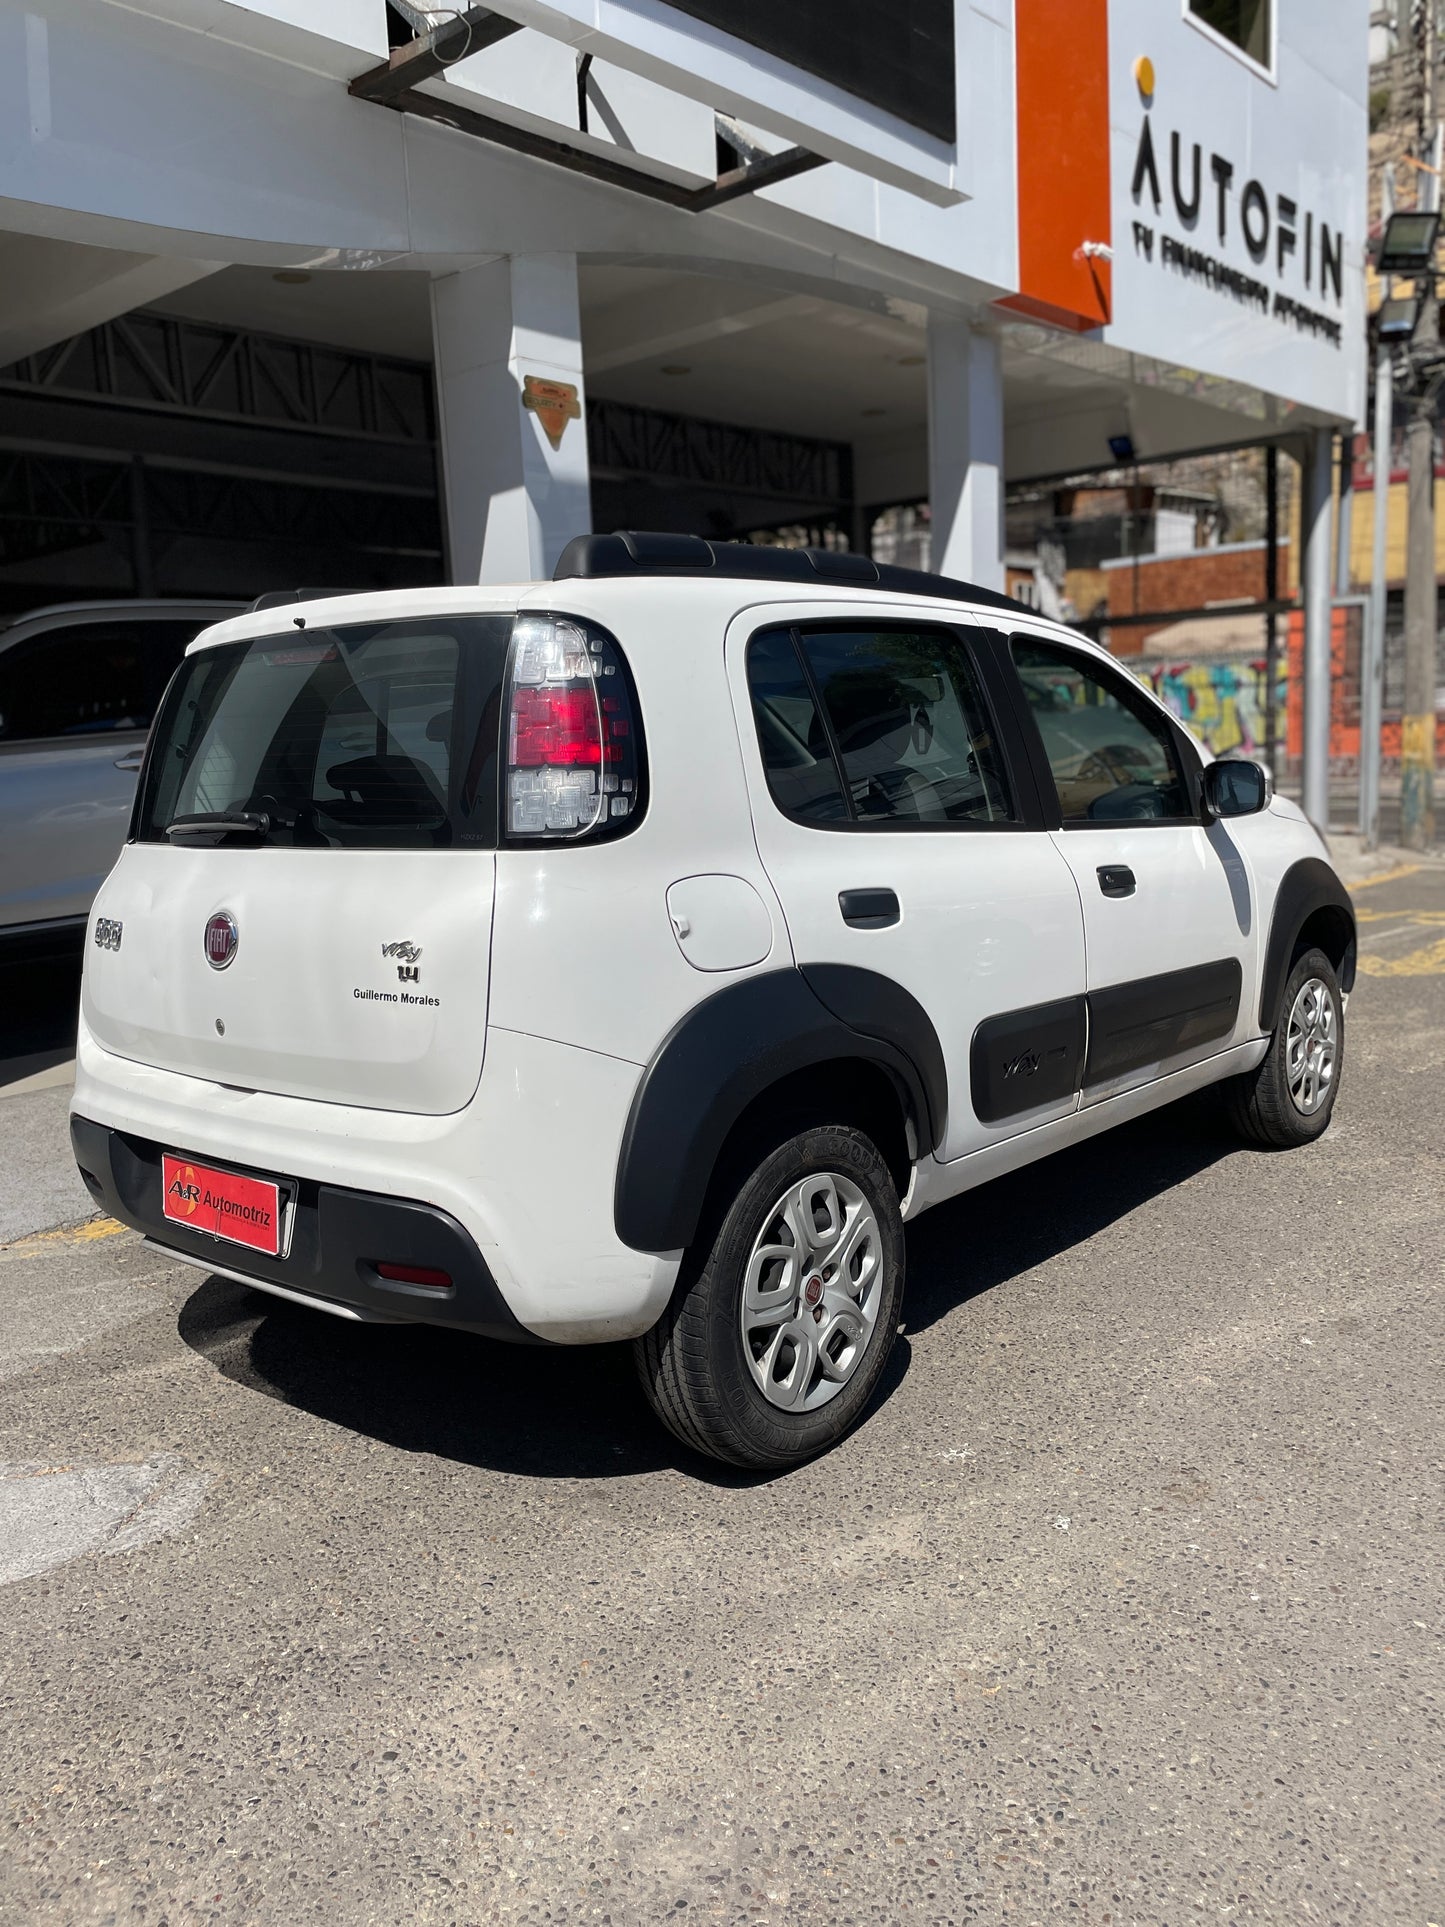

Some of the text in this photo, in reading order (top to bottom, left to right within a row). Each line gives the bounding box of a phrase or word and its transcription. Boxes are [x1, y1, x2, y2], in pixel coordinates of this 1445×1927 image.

[1131, 112, 1343, 308] AUTOFIN
[209, 928, 230, 953] FIAT
[353, 988, 440, 1007] Guillermo Morales
[203, 1190, 271, 1226] Automotriz
